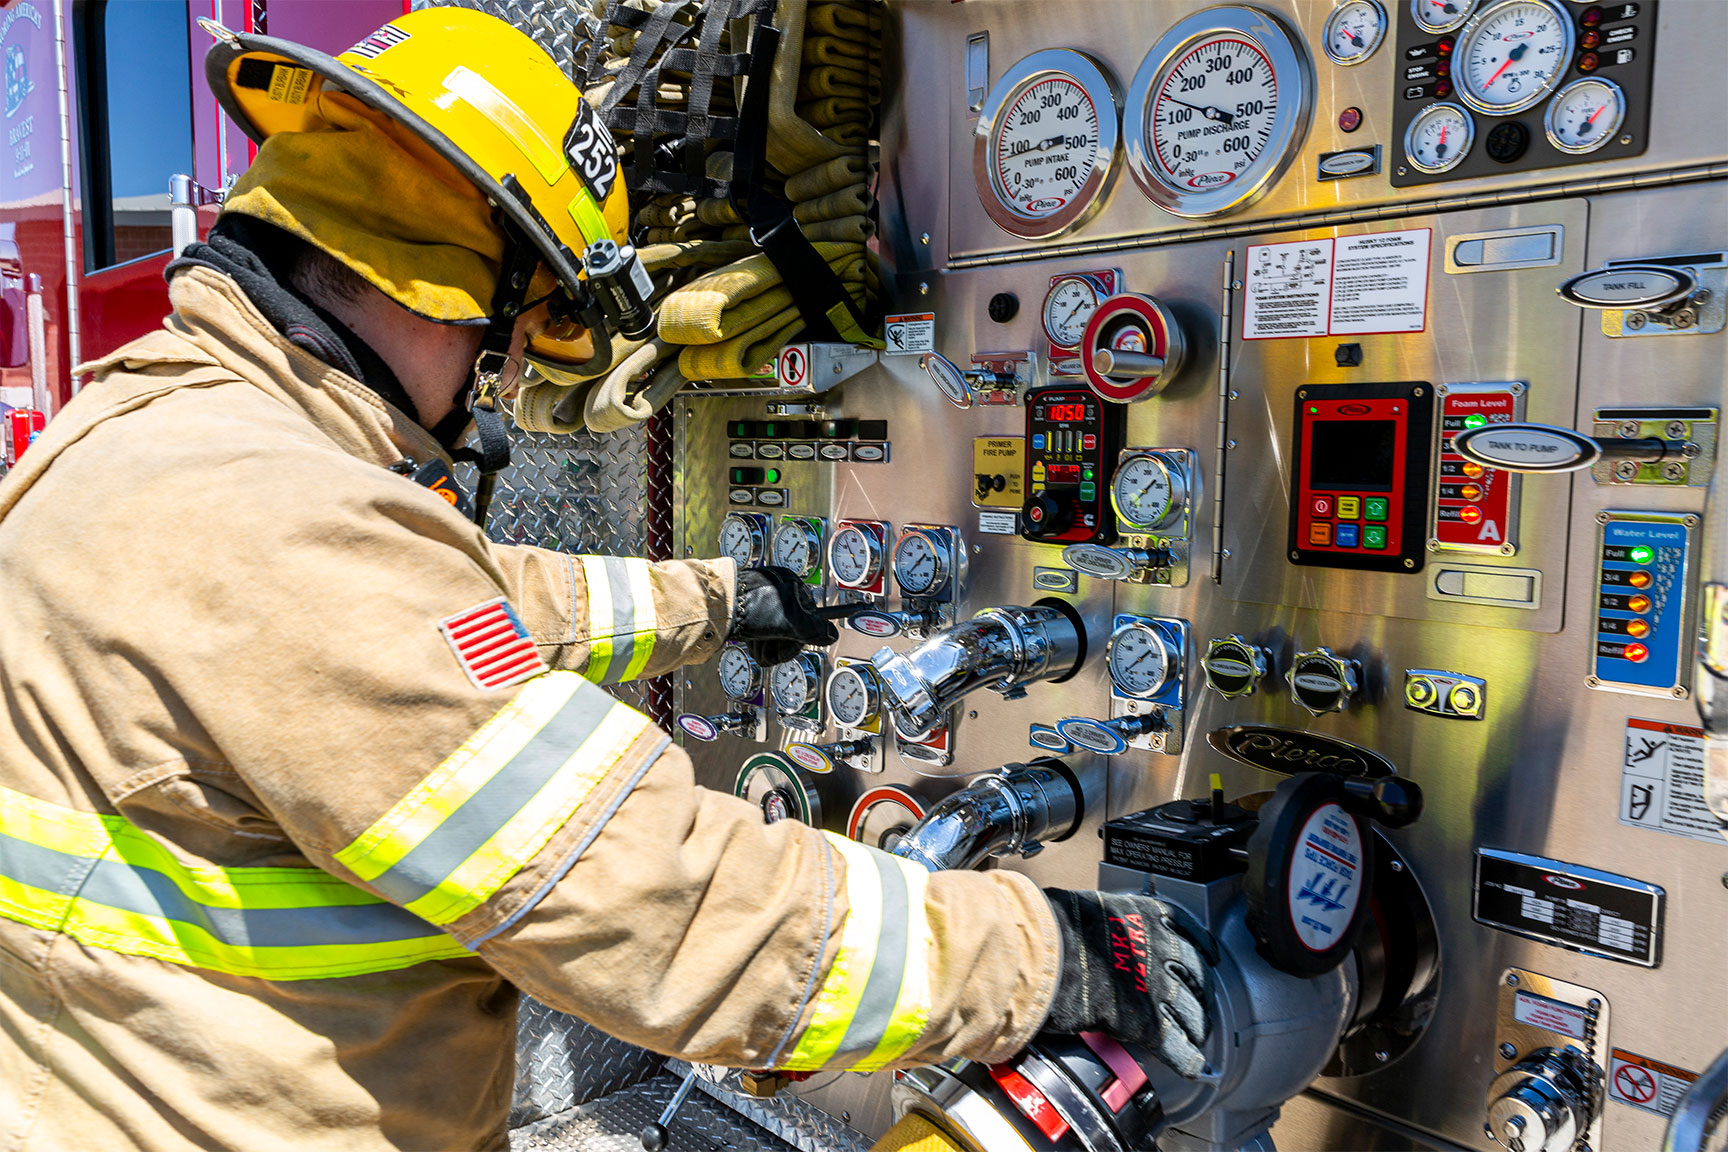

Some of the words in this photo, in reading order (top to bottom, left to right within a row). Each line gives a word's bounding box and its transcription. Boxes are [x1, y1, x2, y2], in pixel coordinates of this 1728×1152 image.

[1492, 32, 1502, 41] 10
[1536, 24, 1547, 33] 20
[1609, 27, 1634, 37] CHECK
[1606, 34, 1634, 44] ENGINE
[1544, 45, 1556, 54] 25
[1205, 54, 1232, 73] 300
[1226, 67, 1253, 86] 400
[1407, 71, 1430, 79] ENGINE
[1180, 74, 1206, 93] 200
[1040, 92, 1062, 110] 300
[1236, 100, 1263, 118] 500
[1020, 110, 1041, 126] 200
[1057, 105, 1079, 120] 400
[1168, 107, 1193, 125] 100
[1177, 128, 1201, 141] PUMP
[1203, 119, 1251, 137] DISCHARGE
[1010, 139, 1031, 155] 100
[1064, 134, 1088, 151] 500
[1223, 135, 1250, 154] 600
[1172, 143, 1182, 159] 0
[568, 123, 617, 199] 252
[1024, 156, 1044, 168] PUMP
[1045, 152, 1071, 165] INTAKE
[1014, 171, 1022, 186] 0
[1055, 165, 1077, 181] 600
[1602, 283, 1626, 291] TANK
[1628, 282, 1646, 290] FILL
[1450, 399, 1477, 408] Foam
[1479, 399, 1507, 408] Level
[1050, 404, 1085, 421] 1050
[1443, 418, 1461, 427] Full
[987, 440, 1013, 448] PRIMER
[1488, 441, 1512, 451] TANK
[1513, 442, 1526, 452] TO
[1527, 442, 1560, 454] PUMP
[983, 449, 998, 457] FIRE
[998, 449, 1017, 457] PUMP
[1441, 464, 1455, 473] 1/2
[1440, 487, 1454, 496] 1/4
[1439, 510, 1461, 518] Refill
[1477, 520, 1500, 541] A
[1612, 527, 1645, 538] Water
[1649, 530, 1679, 540] Level
[1605, 548, 1626, 557] Full
[1603, 573, 1620, 582] 3/4
[1602, 597, 1619, 606] 1/2
[1601, 621, 1618, 630] 1/4
[1599, 644, 1625, 655] Refill
[1235, 733, 1364, 772] Pierce
[1111, 838, 1123, 847] SEE
[1152, 845, 1177, 858] MANUAL
[1178, 852, 1192, 861] FOR
[1303, 847, 1319, 865] TIPS
[1110, 846, 1124, 856] MAX
[1125, 848, 1160, 863] OPERATING
[1161, 857, 1193, 870] PRESSURE
[1319, 854, 1338, 872] FORCE
[1339, 862, 1353, 880] TASK
[1124, 913, 1147, 993] ULTRA
